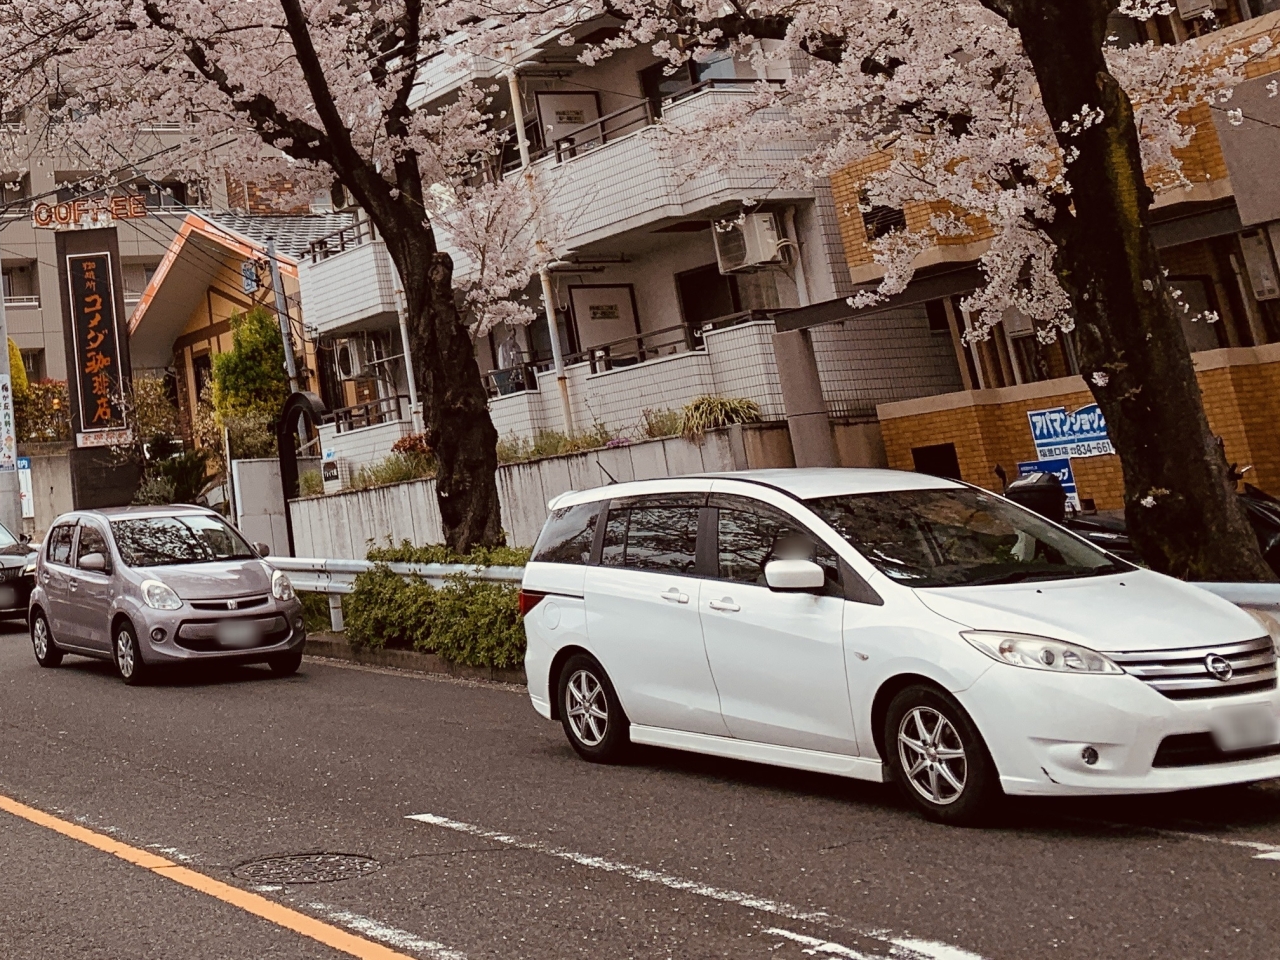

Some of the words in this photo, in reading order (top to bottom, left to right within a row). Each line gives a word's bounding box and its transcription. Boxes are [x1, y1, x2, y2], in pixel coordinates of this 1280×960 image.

[35, 194, 147, 226] COFFEE
[84, 294, 111, 424] コメダ珈琲店
